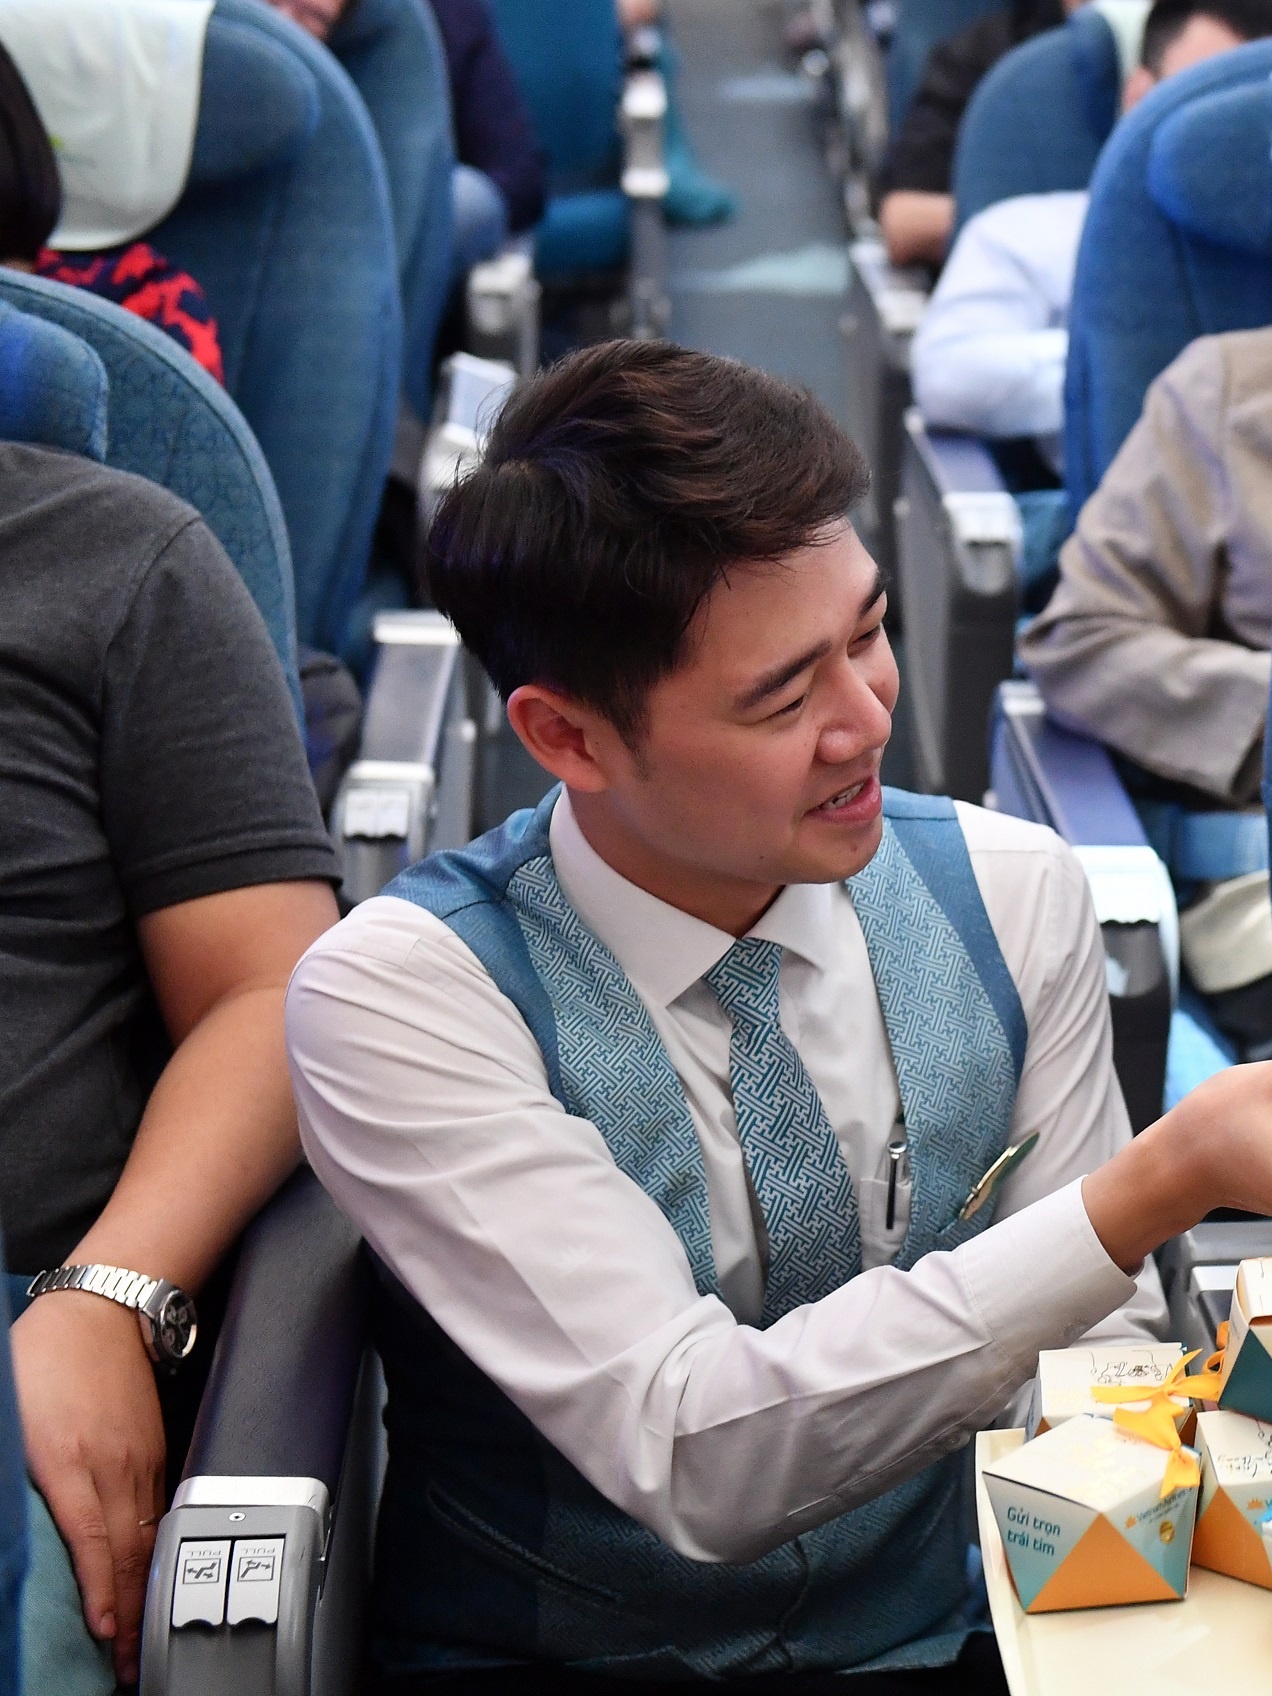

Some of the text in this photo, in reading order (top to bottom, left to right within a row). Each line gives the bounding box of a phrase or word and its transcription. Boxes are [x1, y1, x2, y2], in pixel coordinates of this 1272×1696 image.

[1007, 1505, 1061, 1537] Gửi trọn
[241, 1547, 276, 1555] PULL
[1007, 1529, 1055, 1557] trái tim
[187, 1549, 221, 1557] PULL
